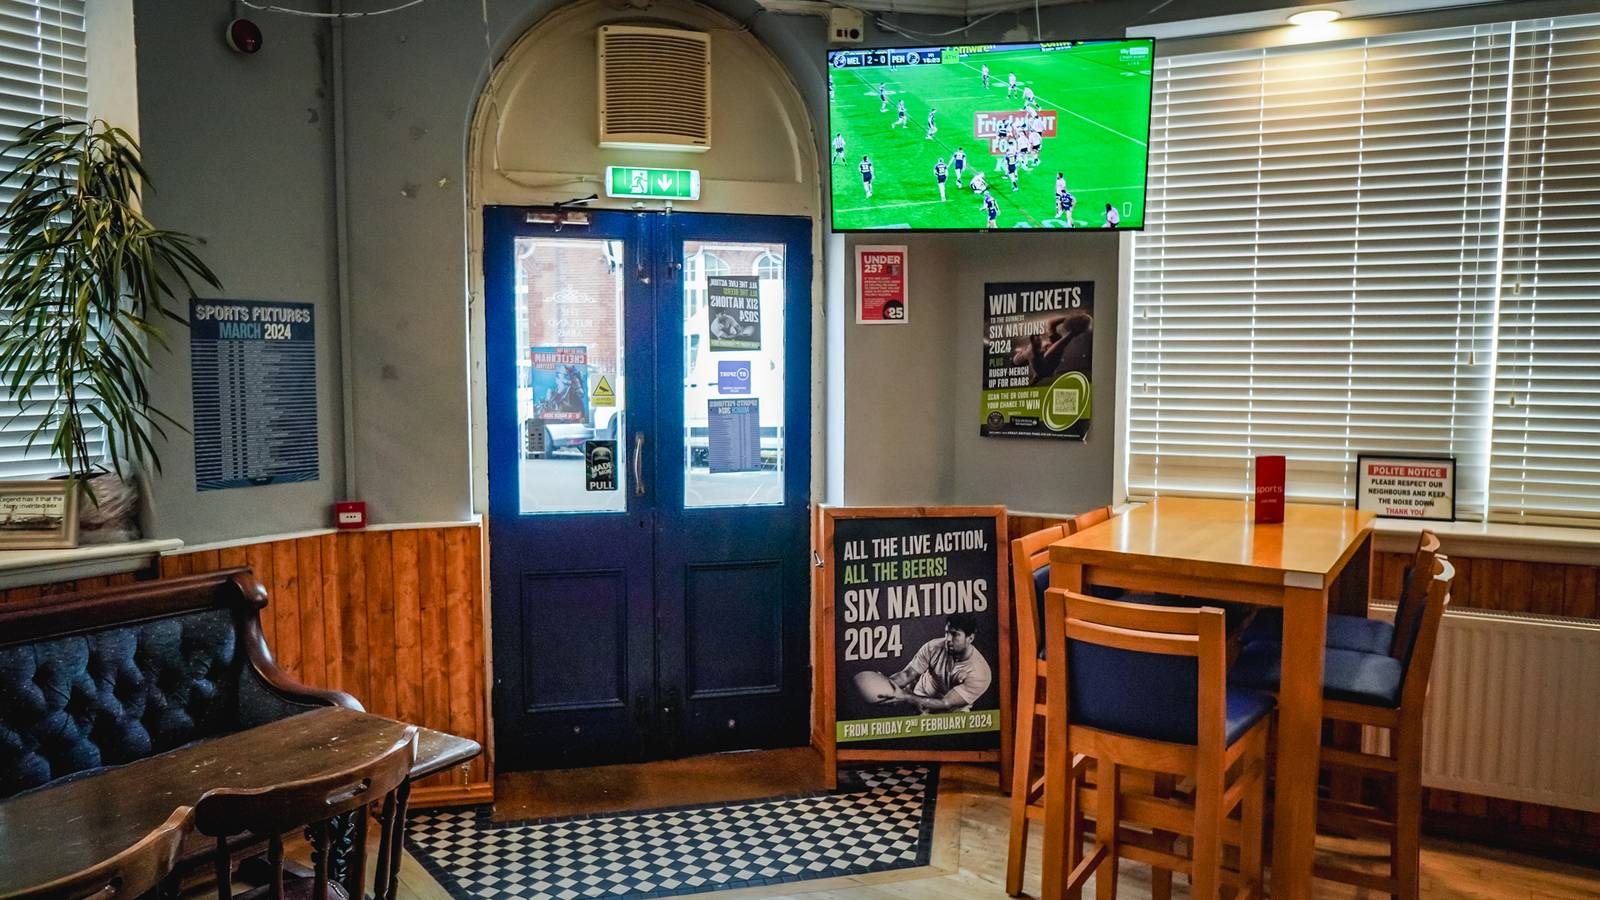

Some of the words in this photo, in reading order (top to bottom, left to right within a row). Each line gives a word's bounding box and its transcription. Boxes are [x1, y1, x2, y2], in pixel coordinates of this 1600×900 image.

[847, 54, 860, 65] MEL
[867, 56, 872, 64] 2
[880, 55, 886, 64] 0
[891, 55, 905, 64] PEN
[864, 255, 900, 264] UNDER
[864, 264, 883, 273] 25?
[989, 292, 1017, 316] WIN
[1020, 286, 1082, 313] TICKETS
[195, 304, 249, 321] SPORTS
[252, 306, 311, 323] FIXTURES
[219, 322, 261, 339] MARCH
[264, 323, 291, 340] 2024
[989, 324, 1003, 339] SIX
[1006, 320, 1045, 338] NATIONS
[989, 339, 1012, 354] 2024
[988, 368, 1008, 378] RUGBY
[1009, 366, 1029, 376] MERCH
[988, 379, 996, 388] UP
[997, 378, 1008, 387] FOR
[1010, 377, 1029, 386] GRABS
[1000, 400, 1017, 408] CHANCE
[1019, 399, 1025, 407] TO
[1026, 399, 1041, 410] WIN
[1373, 466, 1405, 476] POLITE
[1407, 467, 1441, 477] NOTICE
[590, 481, 614, 490] PULL
[1371, 478, 1396, 486] PLEASE
[1397, 479, 1426, 487] RESPECT
[1368, 488, 1410, 496] NEIGHBOURS
[1412, 489, 1426, 497] AND
[1378, 497, 1391, 505] THE
[1393, 498, 1412, 506] NOISE
[1386, 507, 1408, 515] THANK
[843, 540, 868, 561] ALL
[872, 537, 898, 558] THE
[902, 534, 930, 555] LIVE
[935, 529, 988, 552] ACTION,
[843, 564, 868, 584] ALL
[872, 561, 898, 581] THE
[902, 557, 947, 580] BEERS!
[844, 588, 880, 623] SIX
[887, 578, 988, 620] NATIONS
[844, 624, 903, 661] 2024
[843, 723, 868, 737] FROM
[871, 720, 902, 736] FRIDAY
[921, 715, 966, 731] FEBRUARY
[969, 714, 993, 728] 2024
